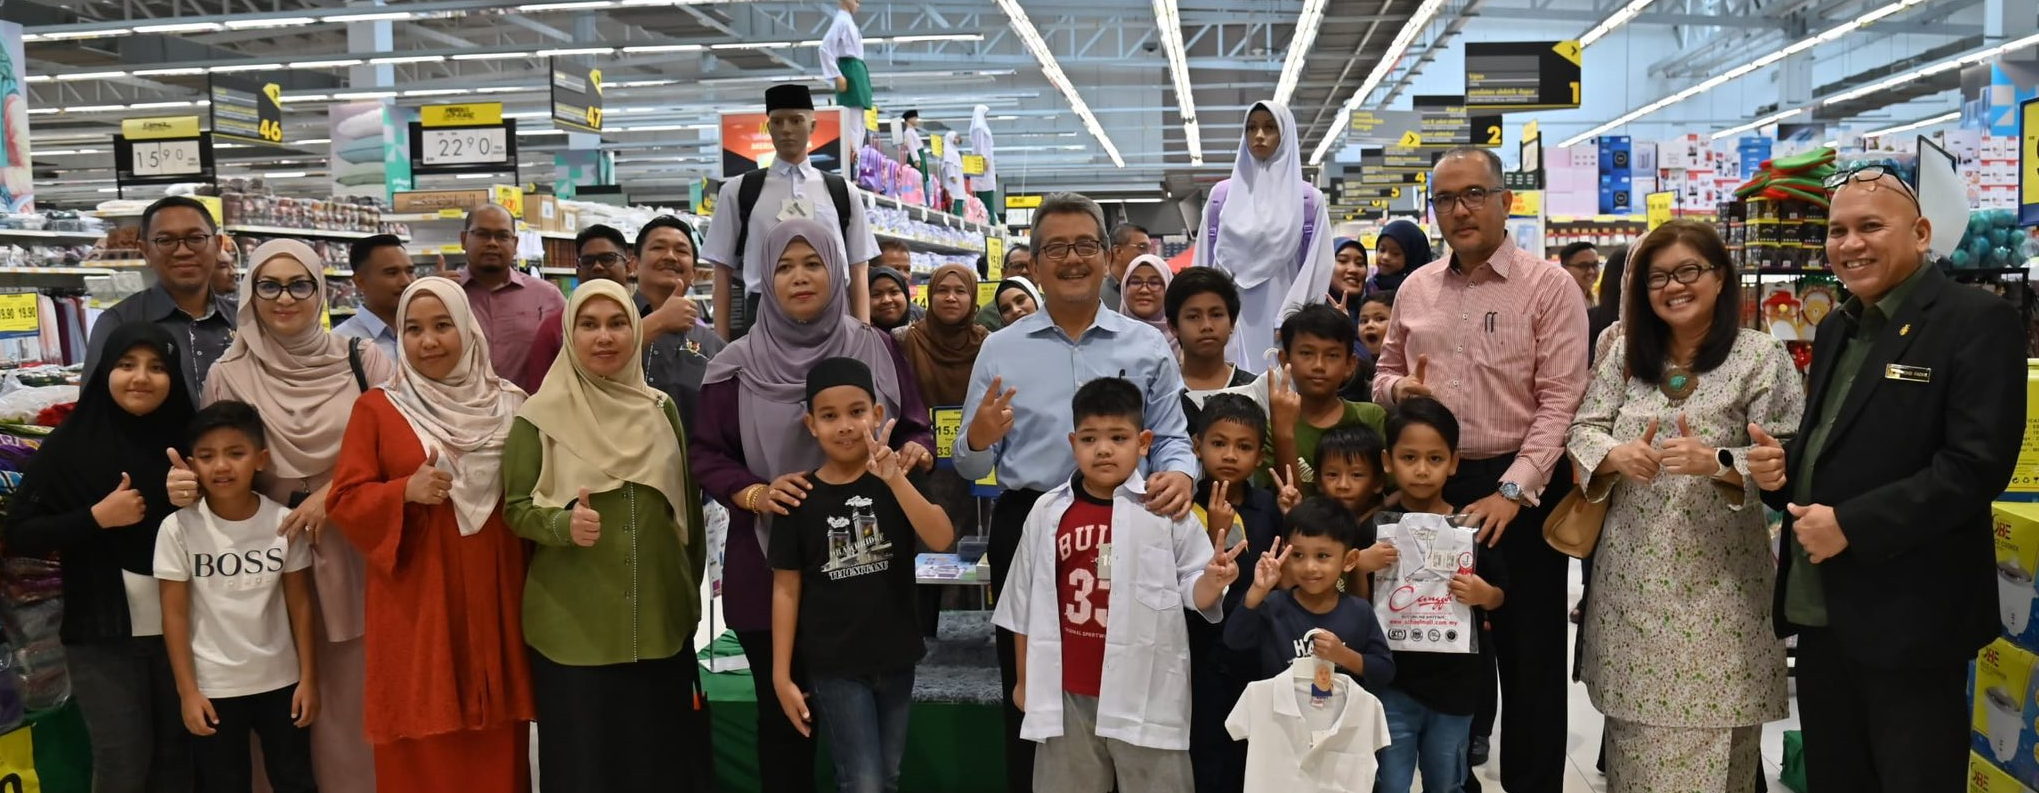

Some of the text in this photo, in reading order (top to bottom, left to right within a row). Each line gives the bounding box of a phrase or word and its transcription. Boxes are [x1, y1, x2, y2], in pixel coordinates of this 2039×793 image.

[1569, 81, 1580, 104] 1
[585, 105, 603, 128] 47
[259, 118, 283, 142] 46
[1487, 125, 1502, 144] 2
[1415, 171, 1426, 184] 4
[1390, 187, 1400, 198] 5
[936, 425, 961, 436] 15.9
[1059, 524, 1108, 561] BUL
[193, 547, 285, 578] BOSS
[1293, 638, 1317, 657] HA
